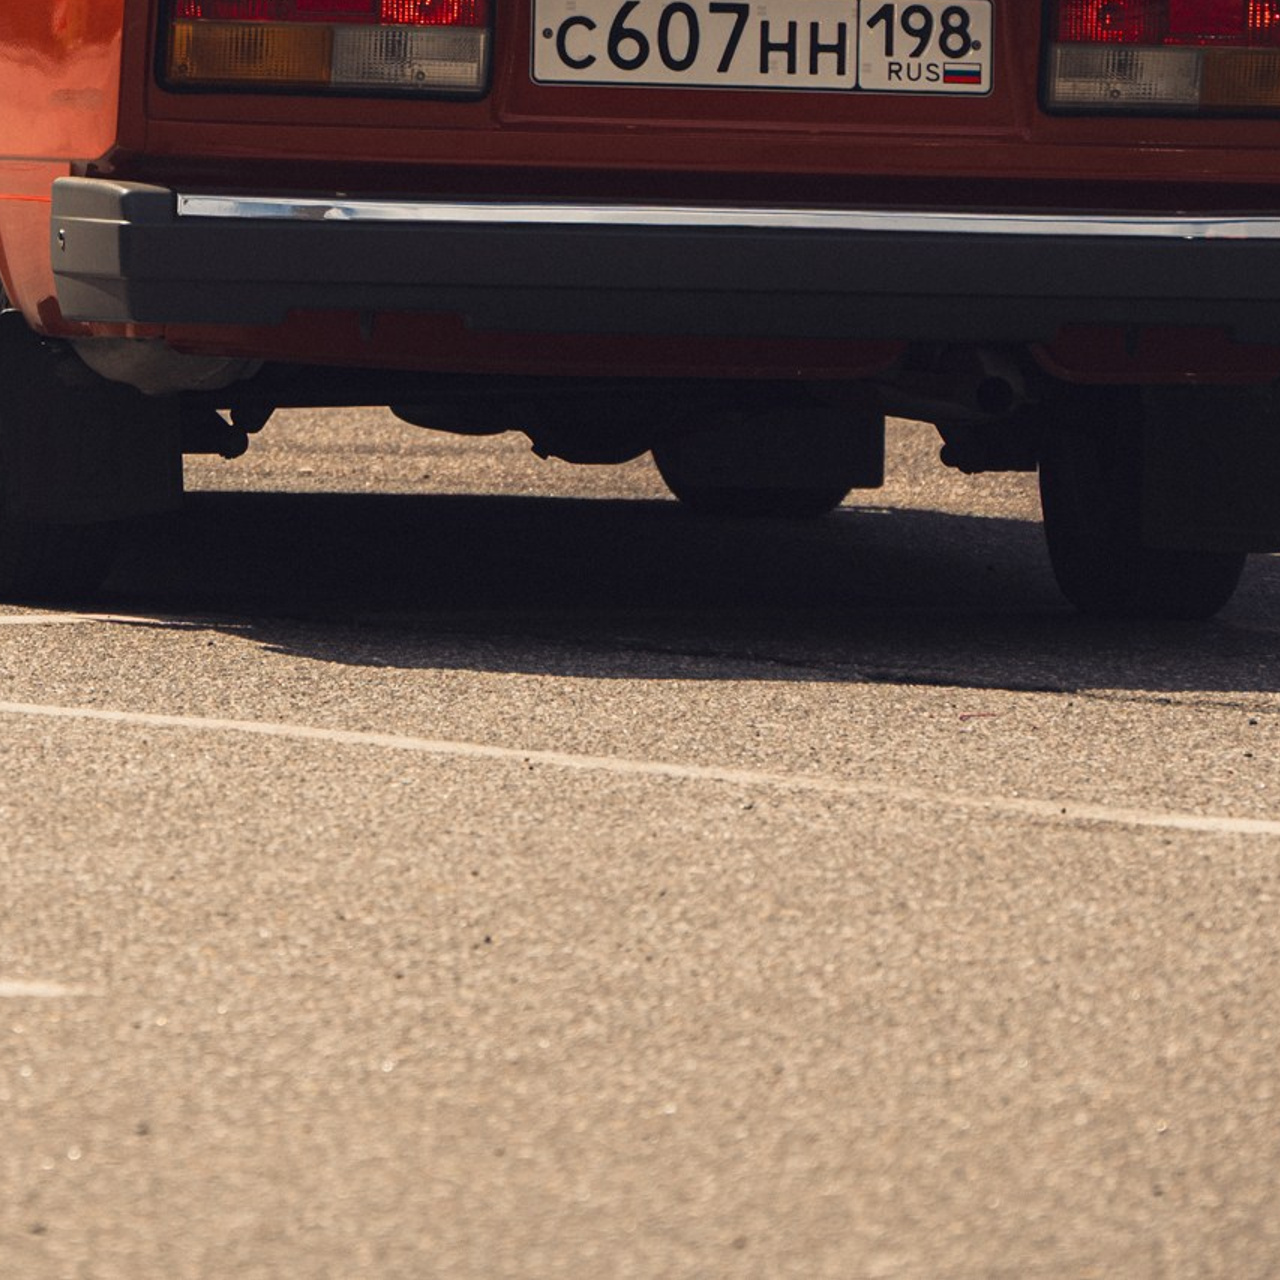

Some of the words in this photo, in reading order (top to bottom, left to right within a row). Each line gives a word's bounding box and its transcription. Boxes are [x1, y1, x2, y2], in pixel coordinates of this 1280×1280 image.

[556, 0, 847, 76] С607НН
[866, 4, 972, 58] 198
[888, 61, 941, 83] RUS
